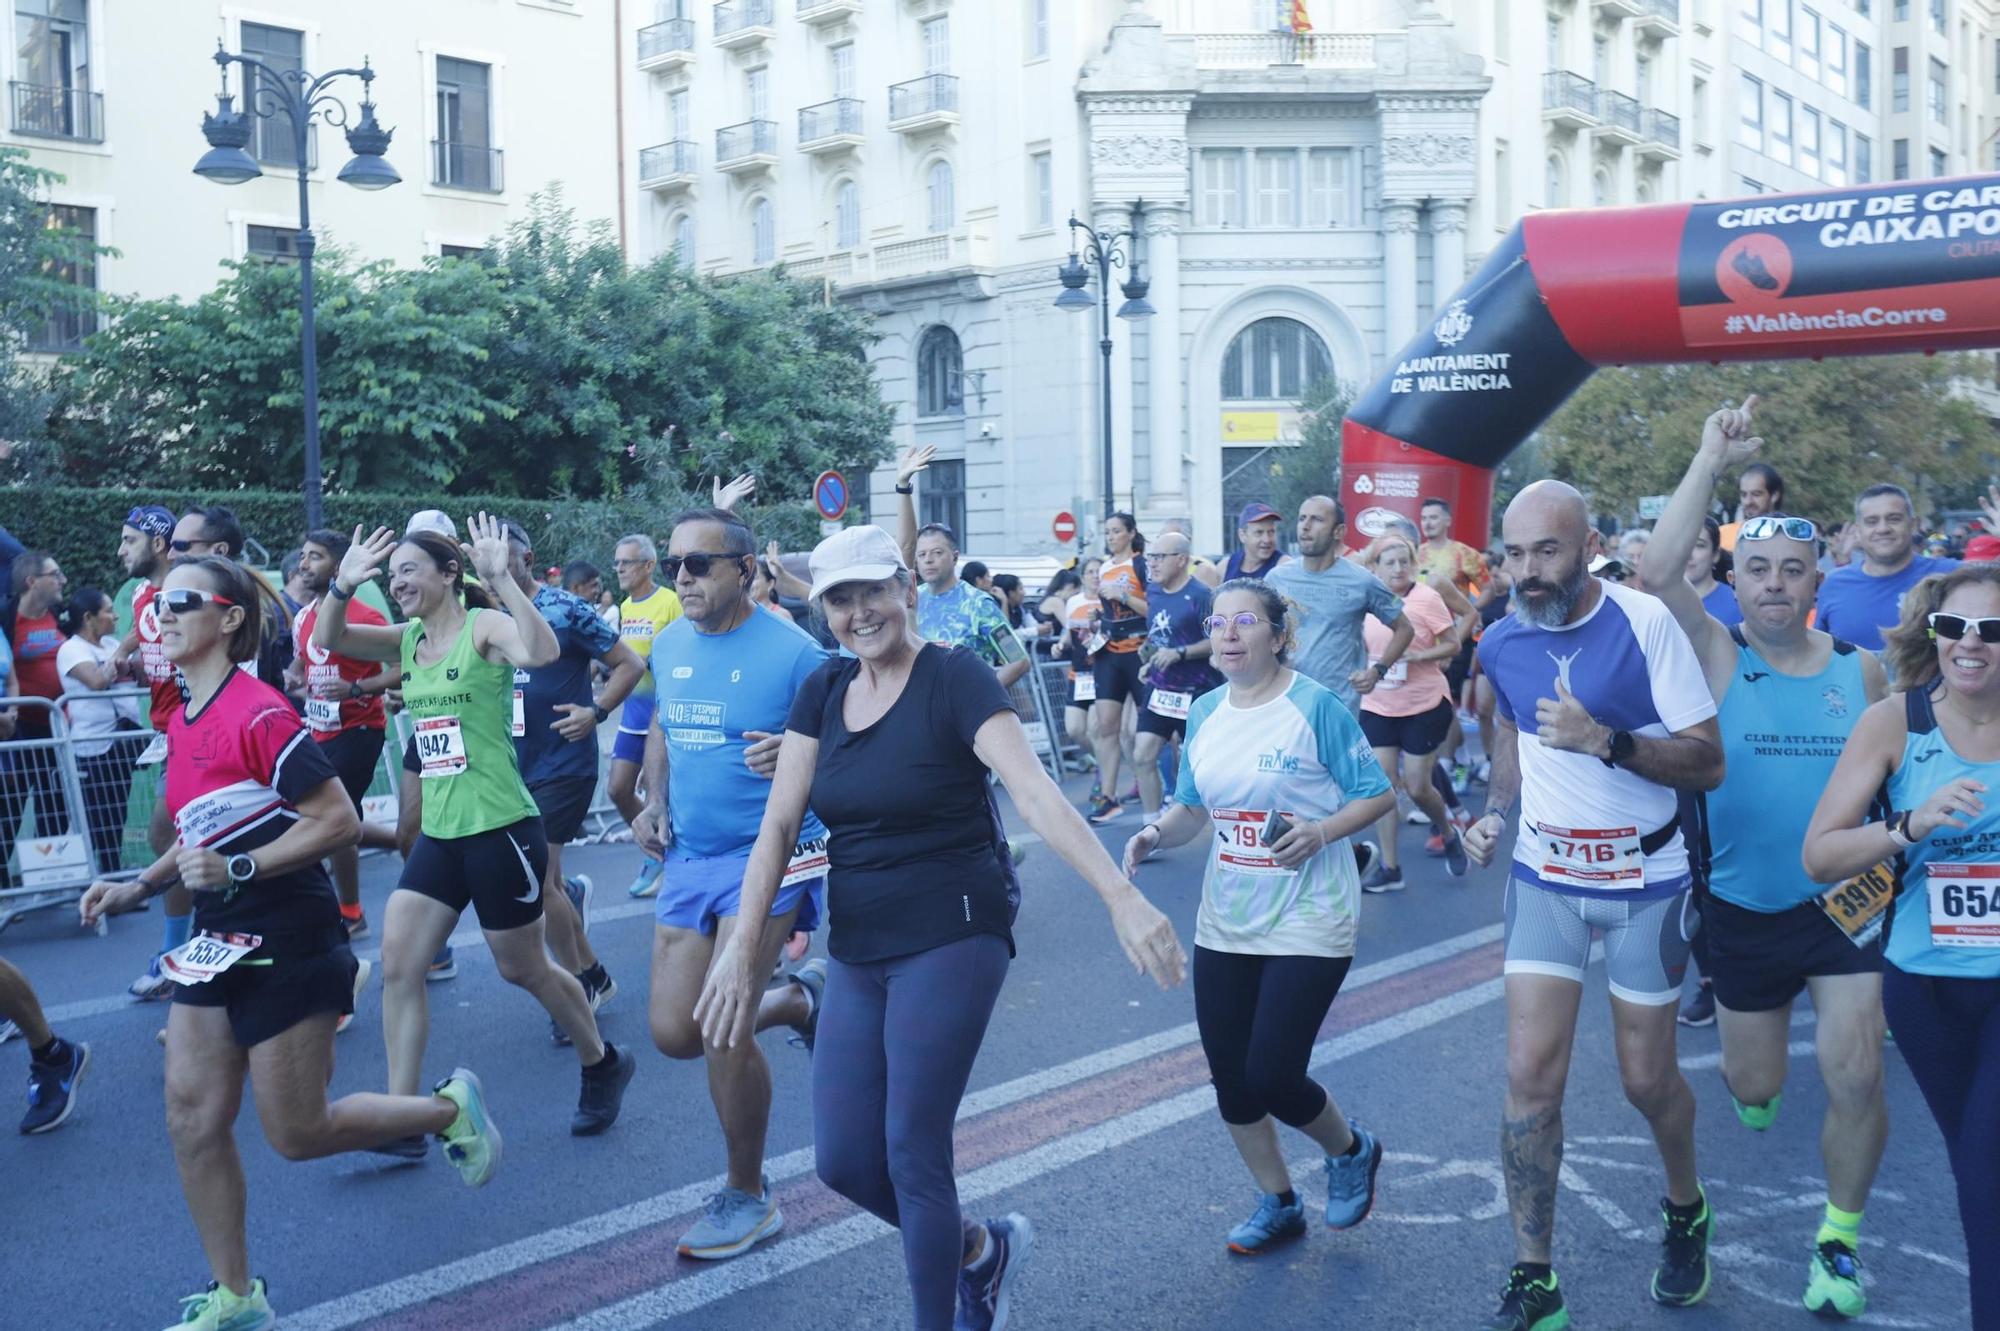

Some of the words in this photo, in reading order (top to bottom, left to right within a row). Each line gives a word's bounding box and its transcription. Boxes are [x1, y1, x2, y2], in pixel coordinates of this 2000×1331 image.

[1717, 199, 1859, 229] CIRCUIT
[1865, 194, 1918, 216] DE
[1922, 185, 2000, 211] CAR
[1819, 215, 1945, 248] CAIXA
[1724, 307, 1947, 334] #ValènciaCorre
[1395, 353, 1511, 375] AJUNTAMENT
[1390, 378, 1413, 393] DE
[1418, 372, 1512, 392] VALÈNCIA
[1374, 489, 1418, 497] ALFONSO
[1375, 480, 1419, 489] TRINIDAD
[141, 514, 170, 536] Buff
[668, 704, 684, 722] 40
[691, 714, 720, 726] POPULAR
[419, 733, 451, 758] 1942
[1744, 734, 1779, 743] CLUB
[1559, 840, 1615, 863] 716
[1931, 834, 1973, 847] CLUB
[1832, 870, 1890, 918] 3916
